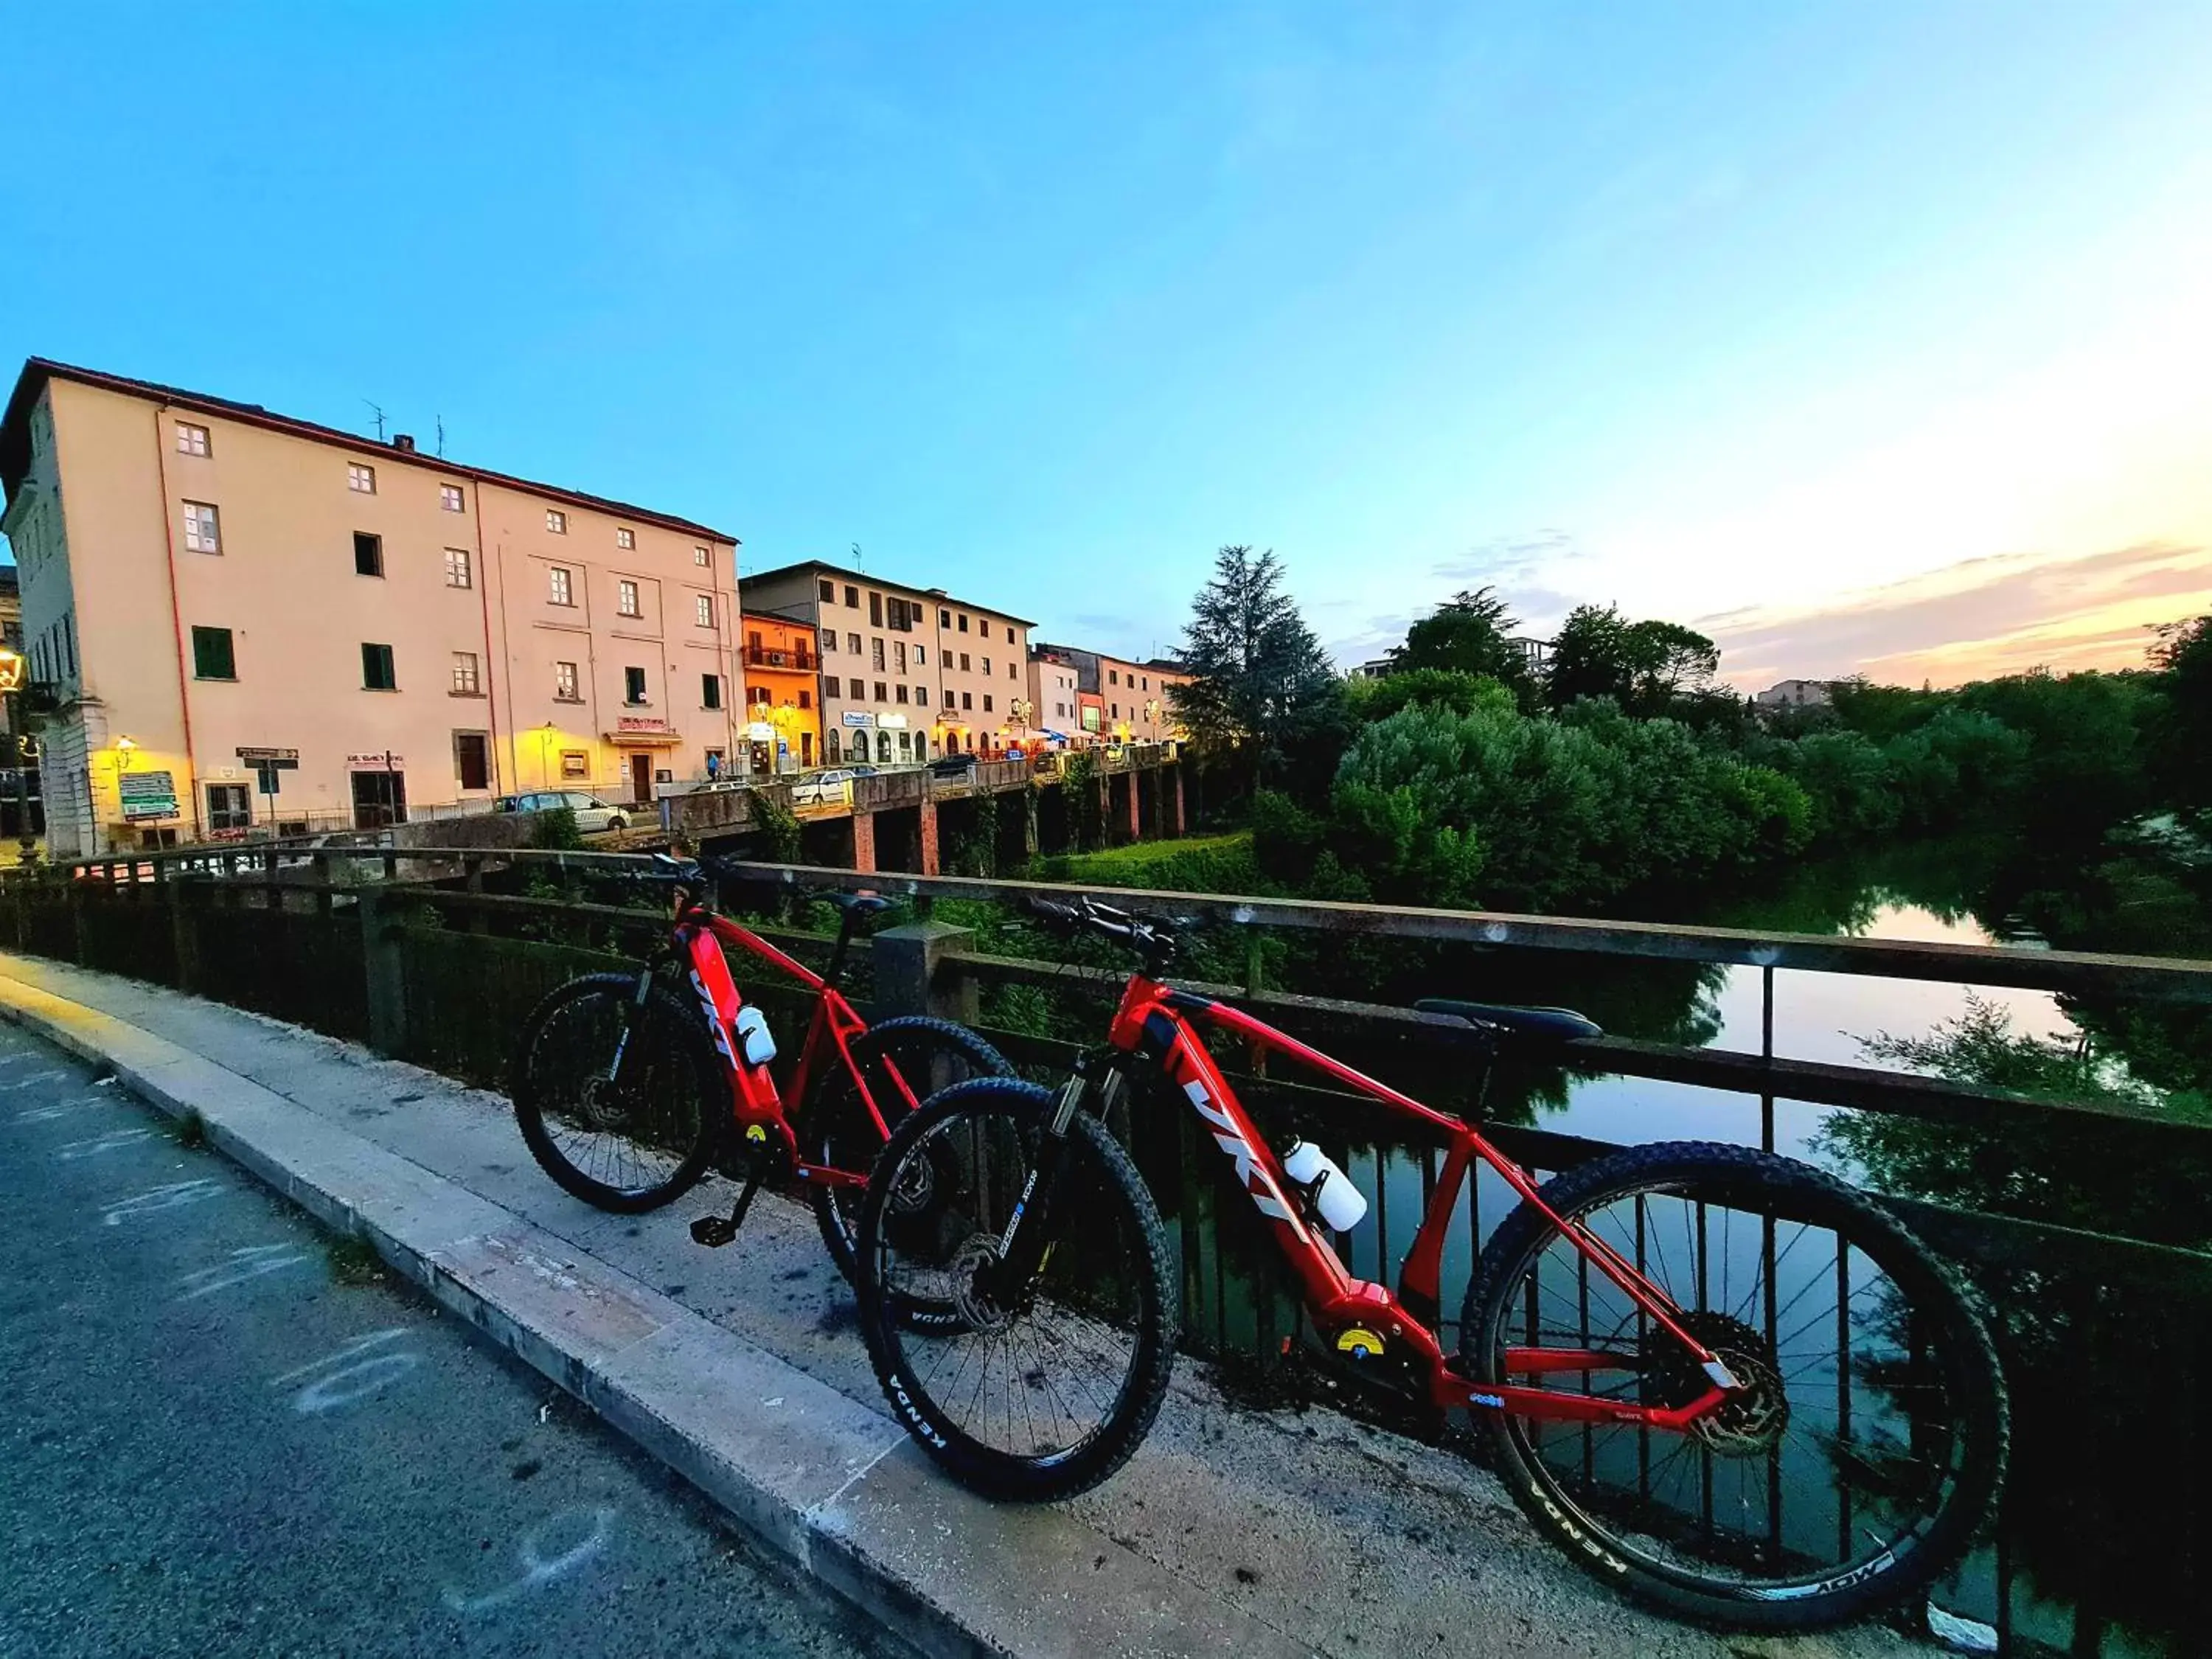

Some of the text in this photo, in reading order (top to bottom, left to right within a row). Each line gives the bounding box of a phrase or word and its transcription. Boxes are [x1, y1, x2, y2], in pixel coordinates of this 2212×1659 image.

[1183, 1079, 1311, 1245] VKT
[911, 1311, 961, 1324] ENDA
[890, 1374, 947, 1449] KENDA
[1531, 1480, 1628, 1573] KENDA
